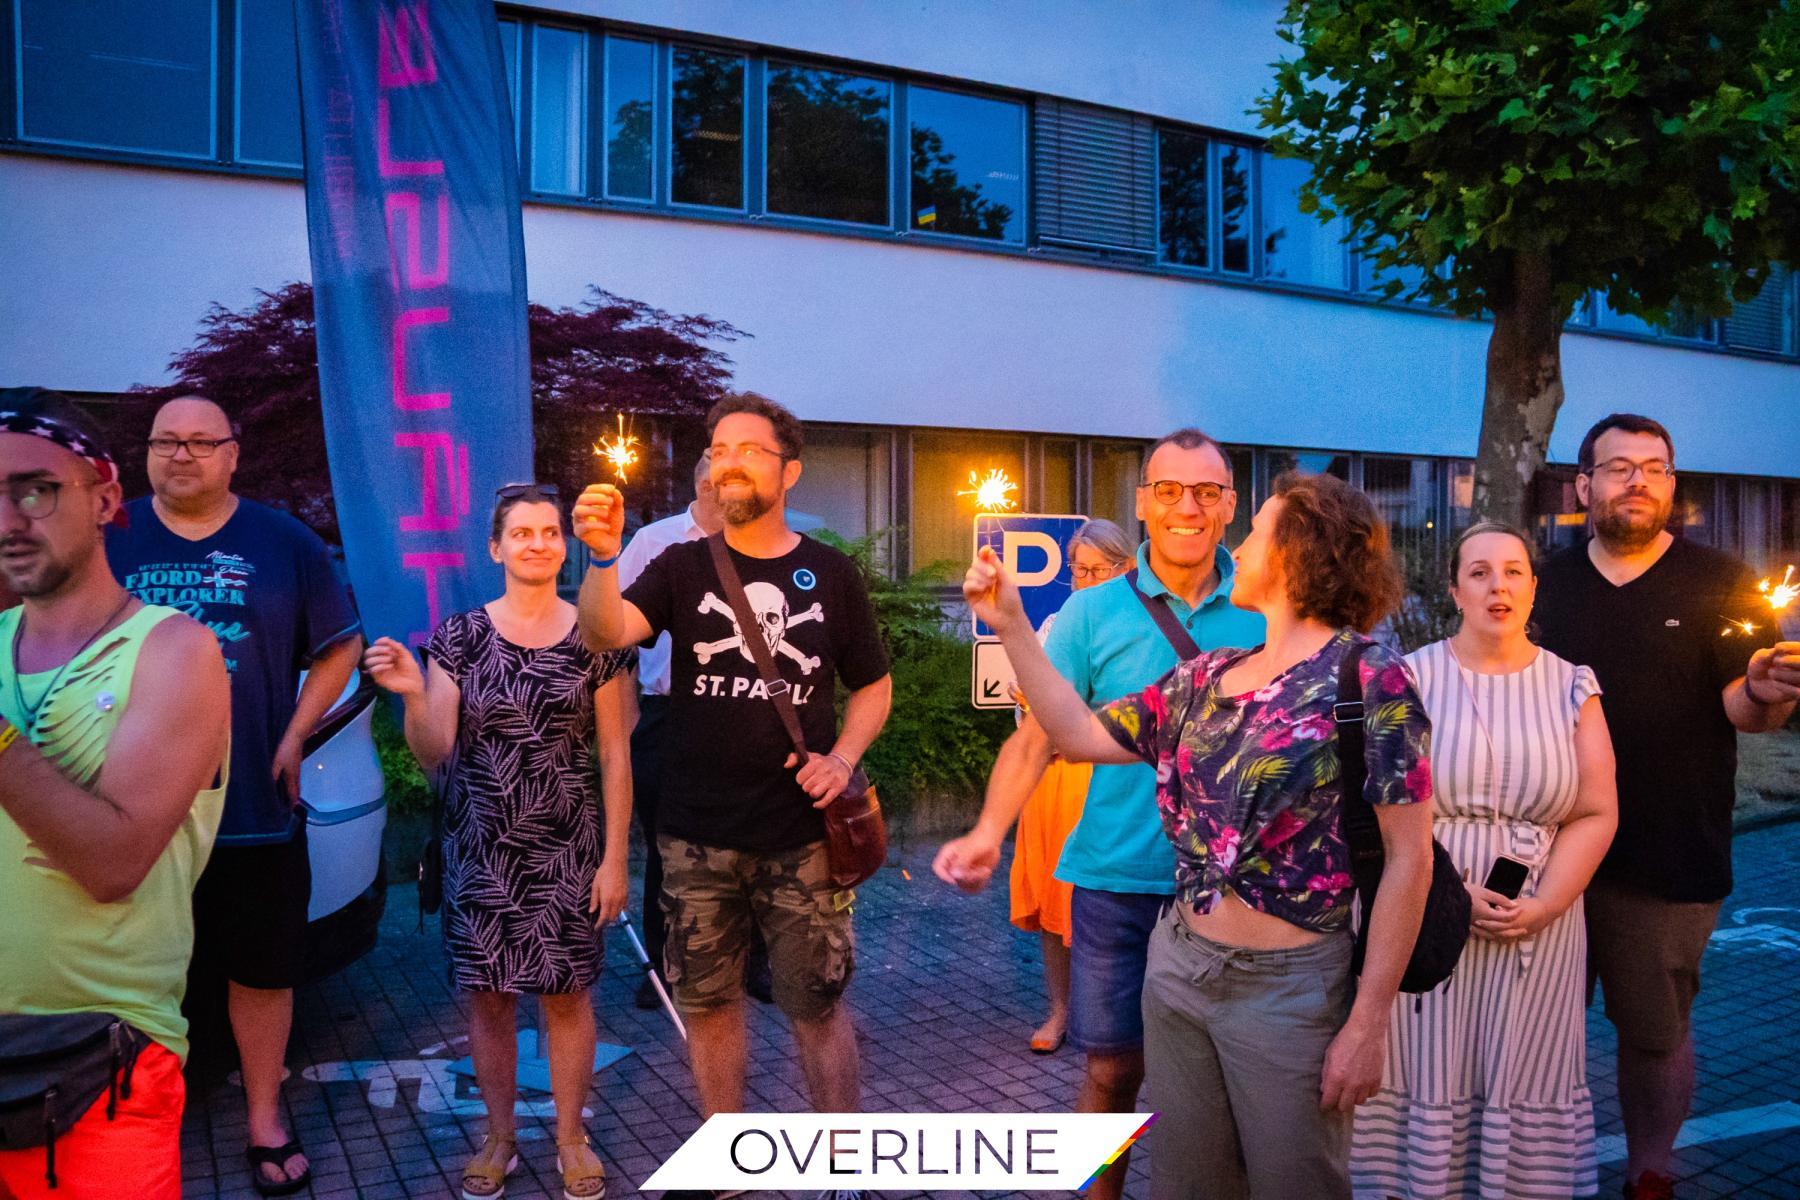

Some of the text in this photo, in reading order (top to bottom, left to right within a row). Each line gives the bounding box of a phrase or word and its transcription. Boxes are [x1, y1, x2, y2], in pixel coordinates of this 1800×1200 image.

[125, 570, 202, 589] FJORD
[693, 674, 815, 705] ST. PALI
